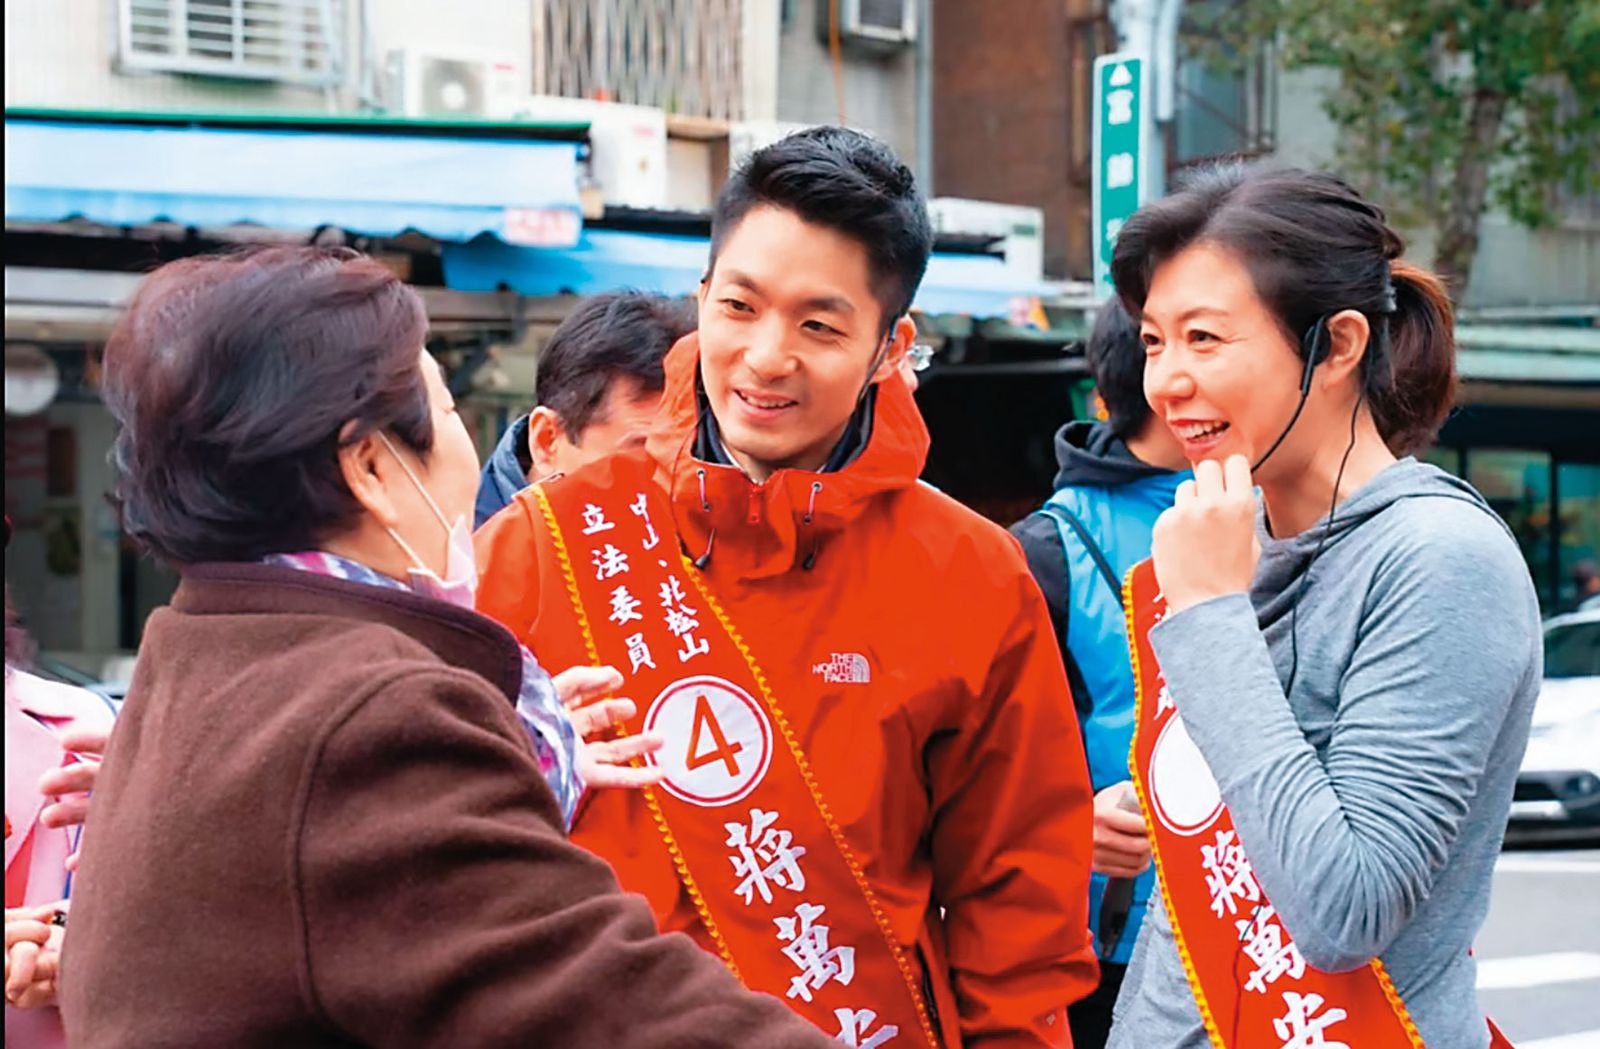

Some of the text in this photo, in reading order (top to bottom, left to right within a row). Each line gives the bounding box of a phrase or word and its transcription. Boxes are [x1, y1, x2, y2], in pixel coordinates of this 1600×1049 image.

[581, 503, 657, 674] 立法委員
[685, 695, 743, 777] 4
